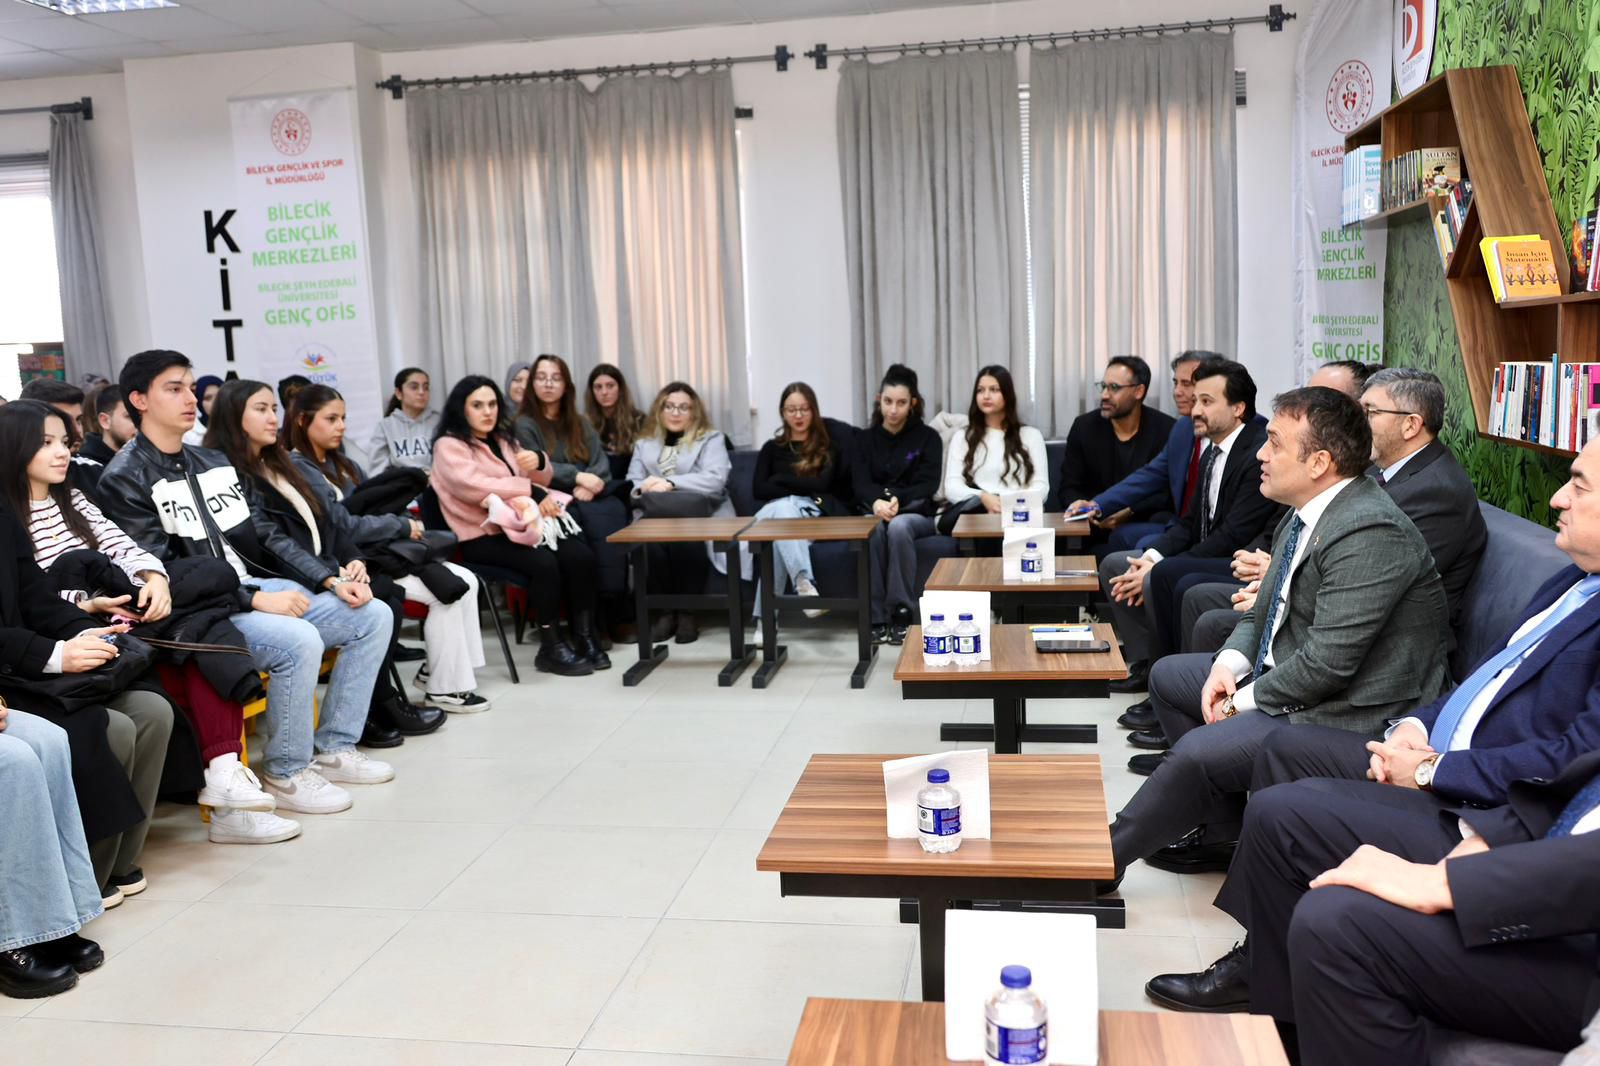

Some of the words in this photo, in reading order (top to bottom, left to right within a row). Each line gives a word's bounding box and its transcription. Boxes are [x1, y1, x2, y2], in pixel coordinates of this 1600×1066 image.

[246, 165, 274, 175] BİLECİK
[276, 162, 309, 173] GENÇLİK
[311, 160, 320, 170] VE
[322, 158, 343, 168] SPOR
[267, 200, 332, 221] BİLECİK
[265, 221, 338, 245] GENÇLİK
[252, 241, 356, 267] MERKEZLERİ
[264, 307, 313, 327] GENÇ
[316, 302, 356, 322] OFİS
[1345, 340, 1380, 361] OFİS
